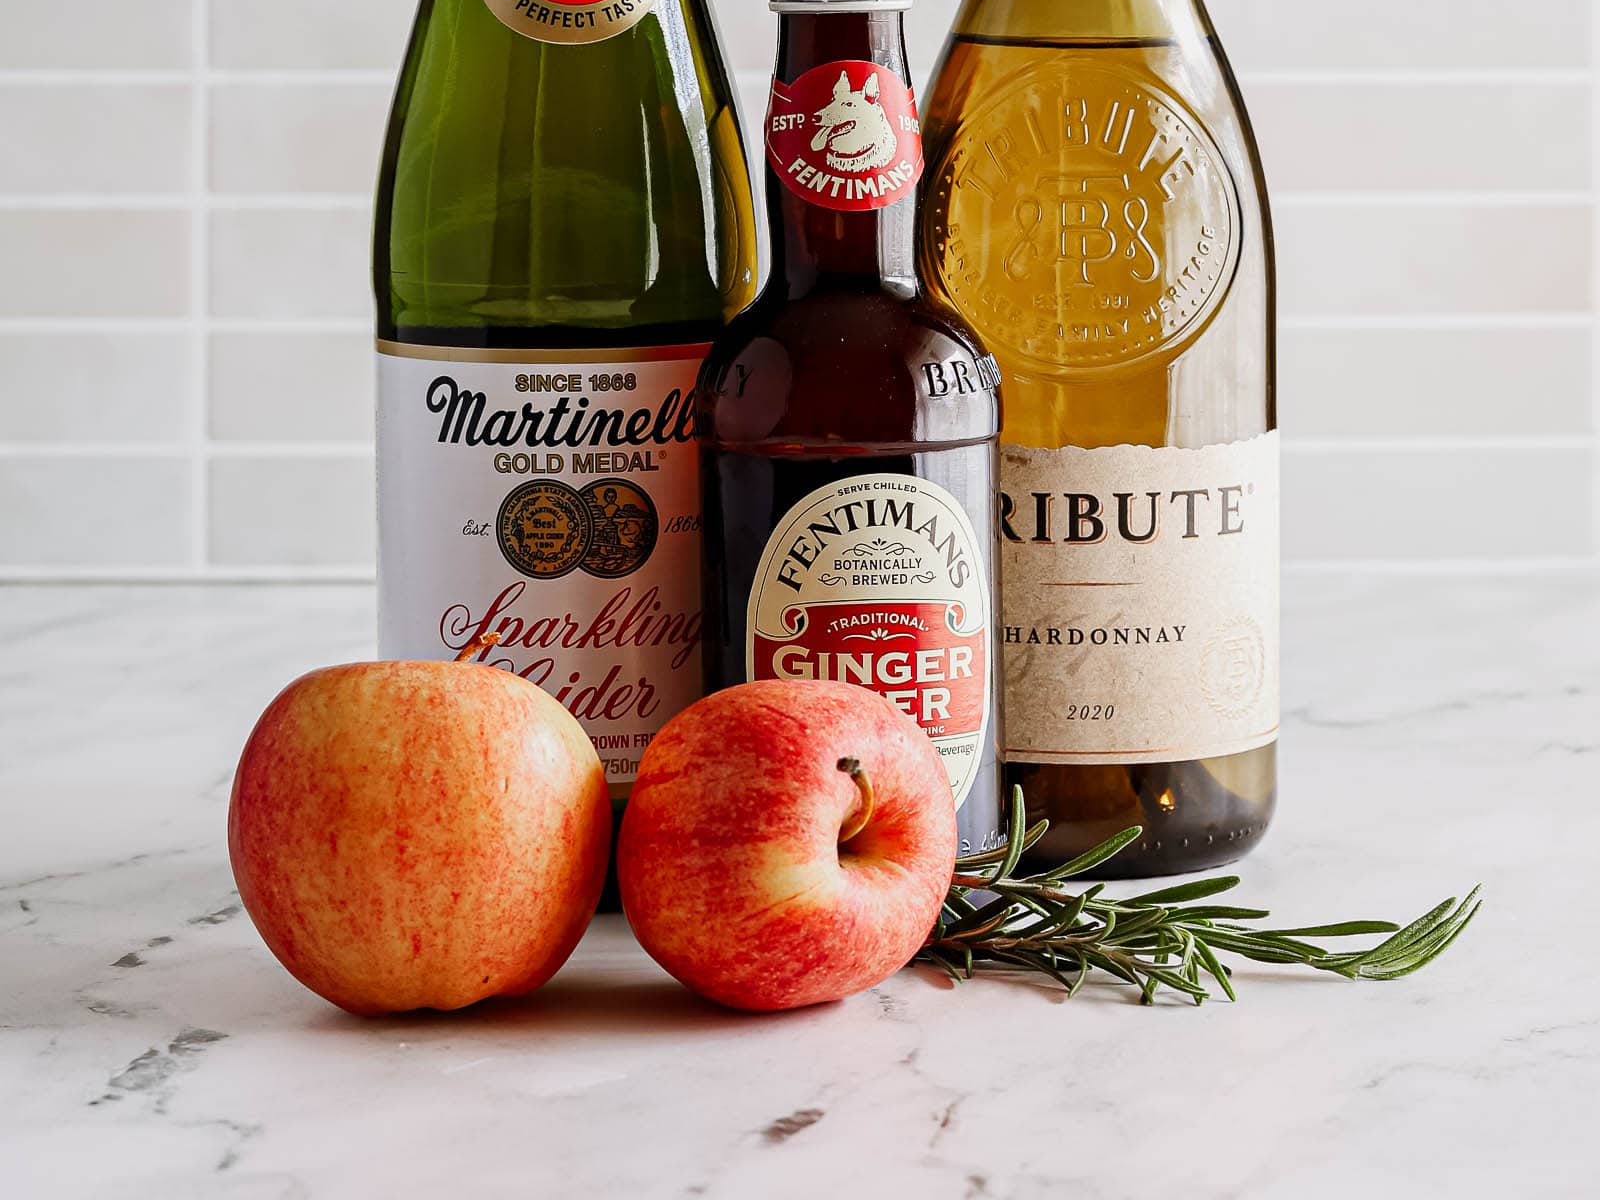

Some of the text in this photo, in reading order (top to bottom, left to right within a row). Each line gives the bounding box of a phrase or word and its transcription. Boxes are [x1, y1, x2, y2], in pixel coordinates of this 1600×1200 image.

[787, 156, 915, 200] FENTIMANS
[514, 372, 638, 393] SINCE 1868
[425, 375, 701, 448] Martinell
[493, 450, 660, 474] GOLD MEDAL
[837, 481, 918, 497] SERVE CHILLED
[999, 484, 1246, 545] RIBUTE
[461, 519, 491, 537] Est.
[776, 498, 971, 594] FENTIMANS
[833, 557, 923, 571] BOTANICALLY
[851, 573, 909, 586] BREWED
[439, 580, 706, 671] Sparkling
[829, 611, 928, 633] TRADITIONAL
[1004, 625, 1188, 646] HARDONNAY
[772, 644, 975, 686] GINGER
[880, 686, 952, 722] ER
[1066, 704, 1116, 721] 2020
[589, 734, 630, 750] ROWN
[935, 741, 976, 757] Beverage
[600, 757, 641, 775] 750m
